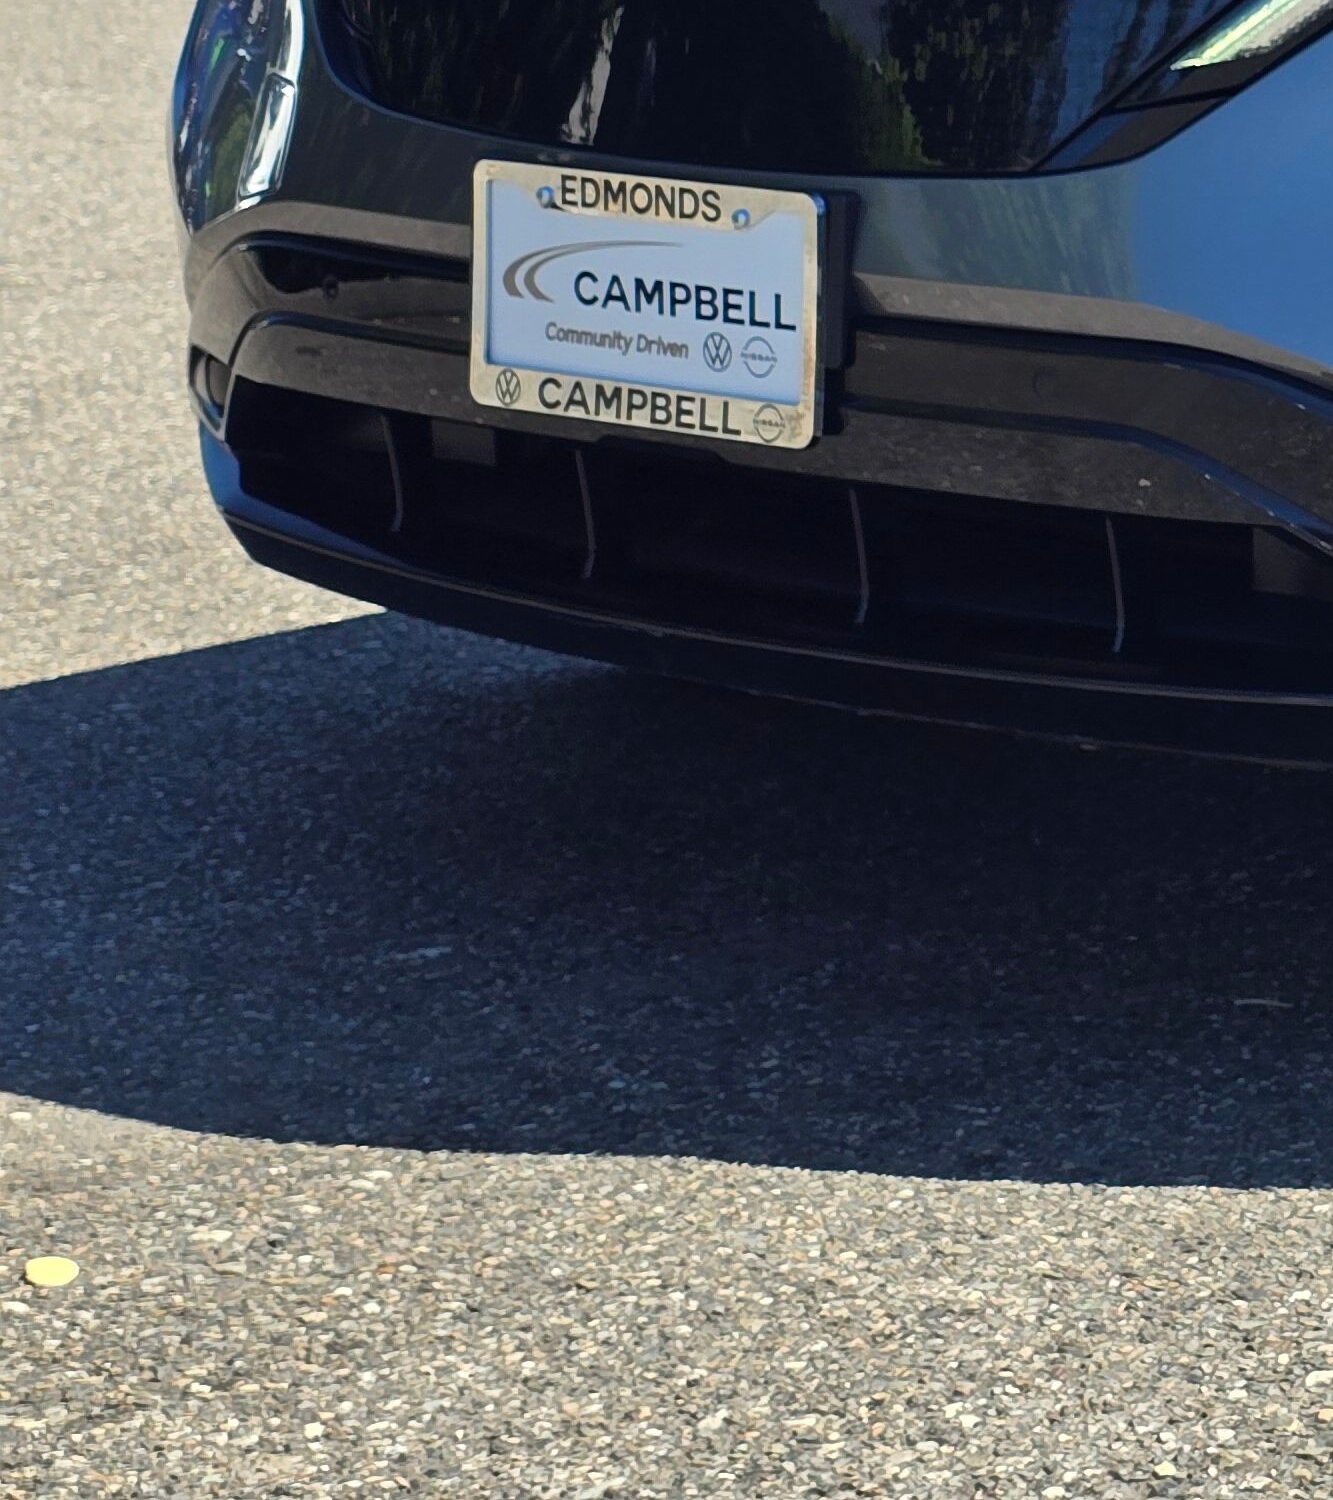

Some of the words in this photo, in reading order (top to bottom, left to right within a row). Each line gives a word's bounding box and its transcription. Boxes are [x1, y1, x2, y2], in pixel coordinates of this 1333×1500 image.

[560, 174, 722, 223] EDMONDS
[574, 270, 797, 331] CAMPBELL
[545, 321, 633, 356] Community
[636, 335, 689, 360] Driven
[538, 377, 742, 436] CAMPBELL
